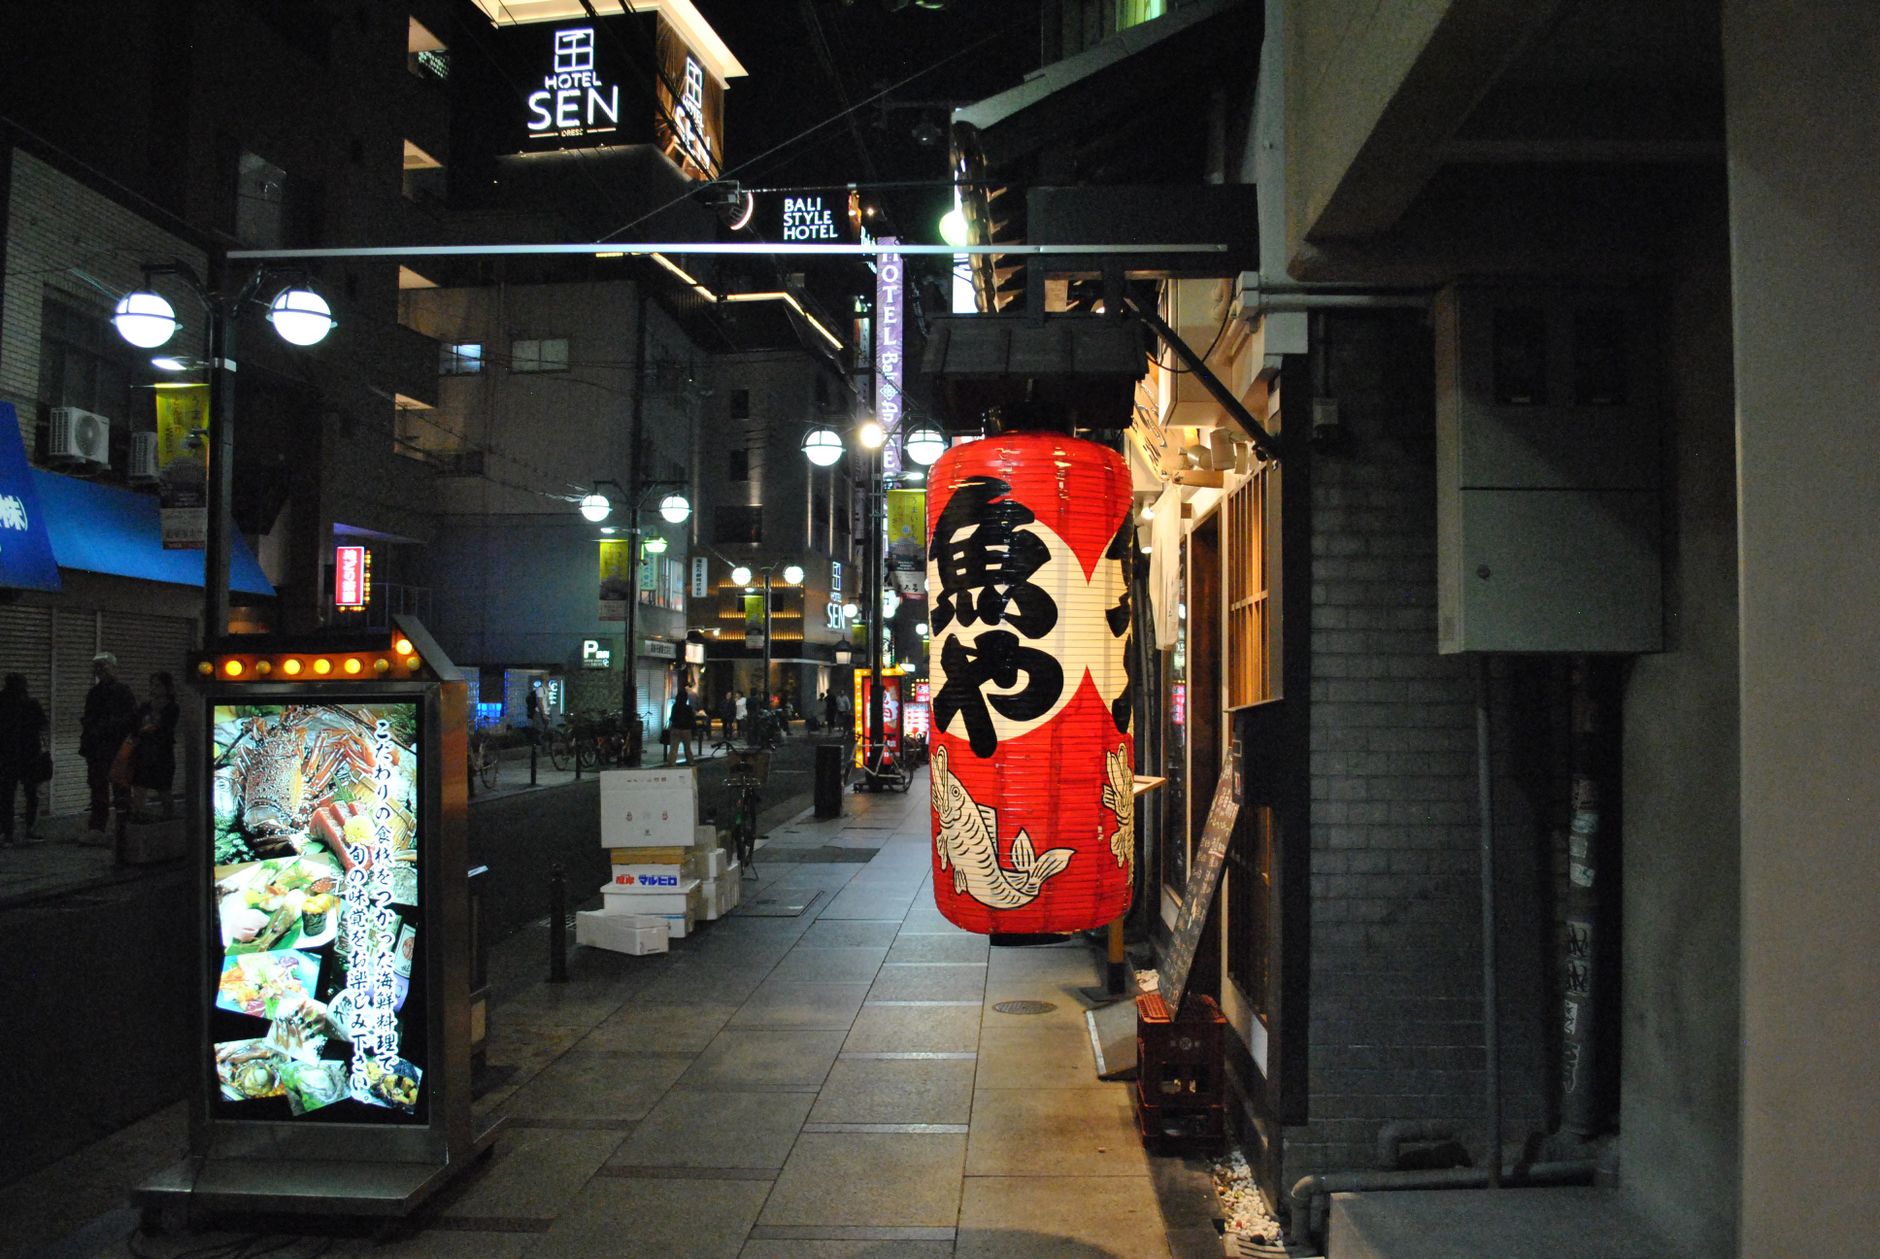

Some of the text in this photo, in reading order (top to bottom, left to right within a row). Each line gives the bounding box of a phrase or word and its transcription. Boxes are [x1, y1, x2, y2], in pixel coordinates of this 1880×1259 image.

[544, 72, 602, 89] HOTEL
[527, 85, 619, 130] SEN
[784, 197, 821, 212] BALI
[783, 211, 832, 227] STYLE
[783, 225, 838, 240] HOTEL
[827, 603, 846, 629] SEN
[929, 476, 1064, 759] 魚や
[639, 875, 677, 886] マルヒロ
[375, 722, 396, 1070] こだわりの食材をつかった海鮮料理で
